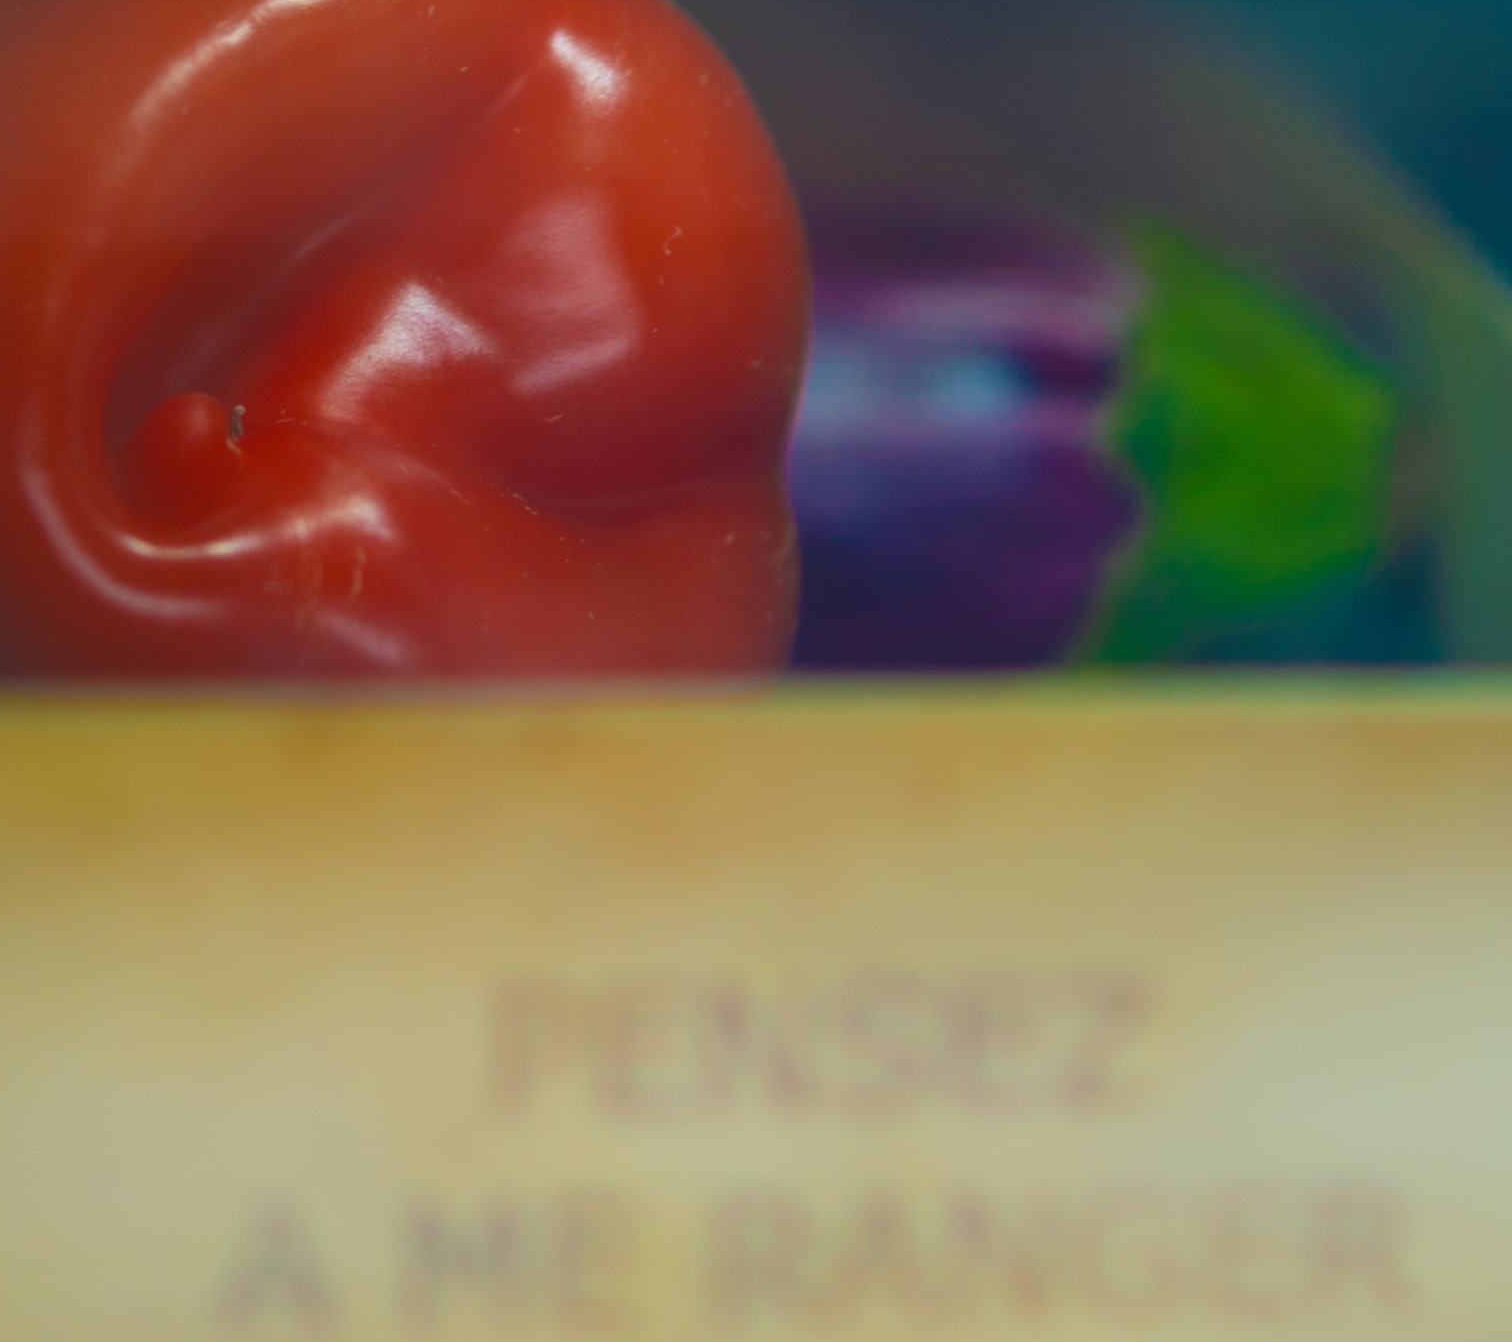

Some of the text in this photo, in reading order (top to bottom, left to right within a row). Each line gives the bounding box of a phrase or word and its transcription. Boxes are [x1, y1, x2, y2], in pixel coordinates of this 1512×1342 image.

[491, 967, 1164, 1123] PENSEZ
[212, 1179, 1417, 1337] A ME RANGER
